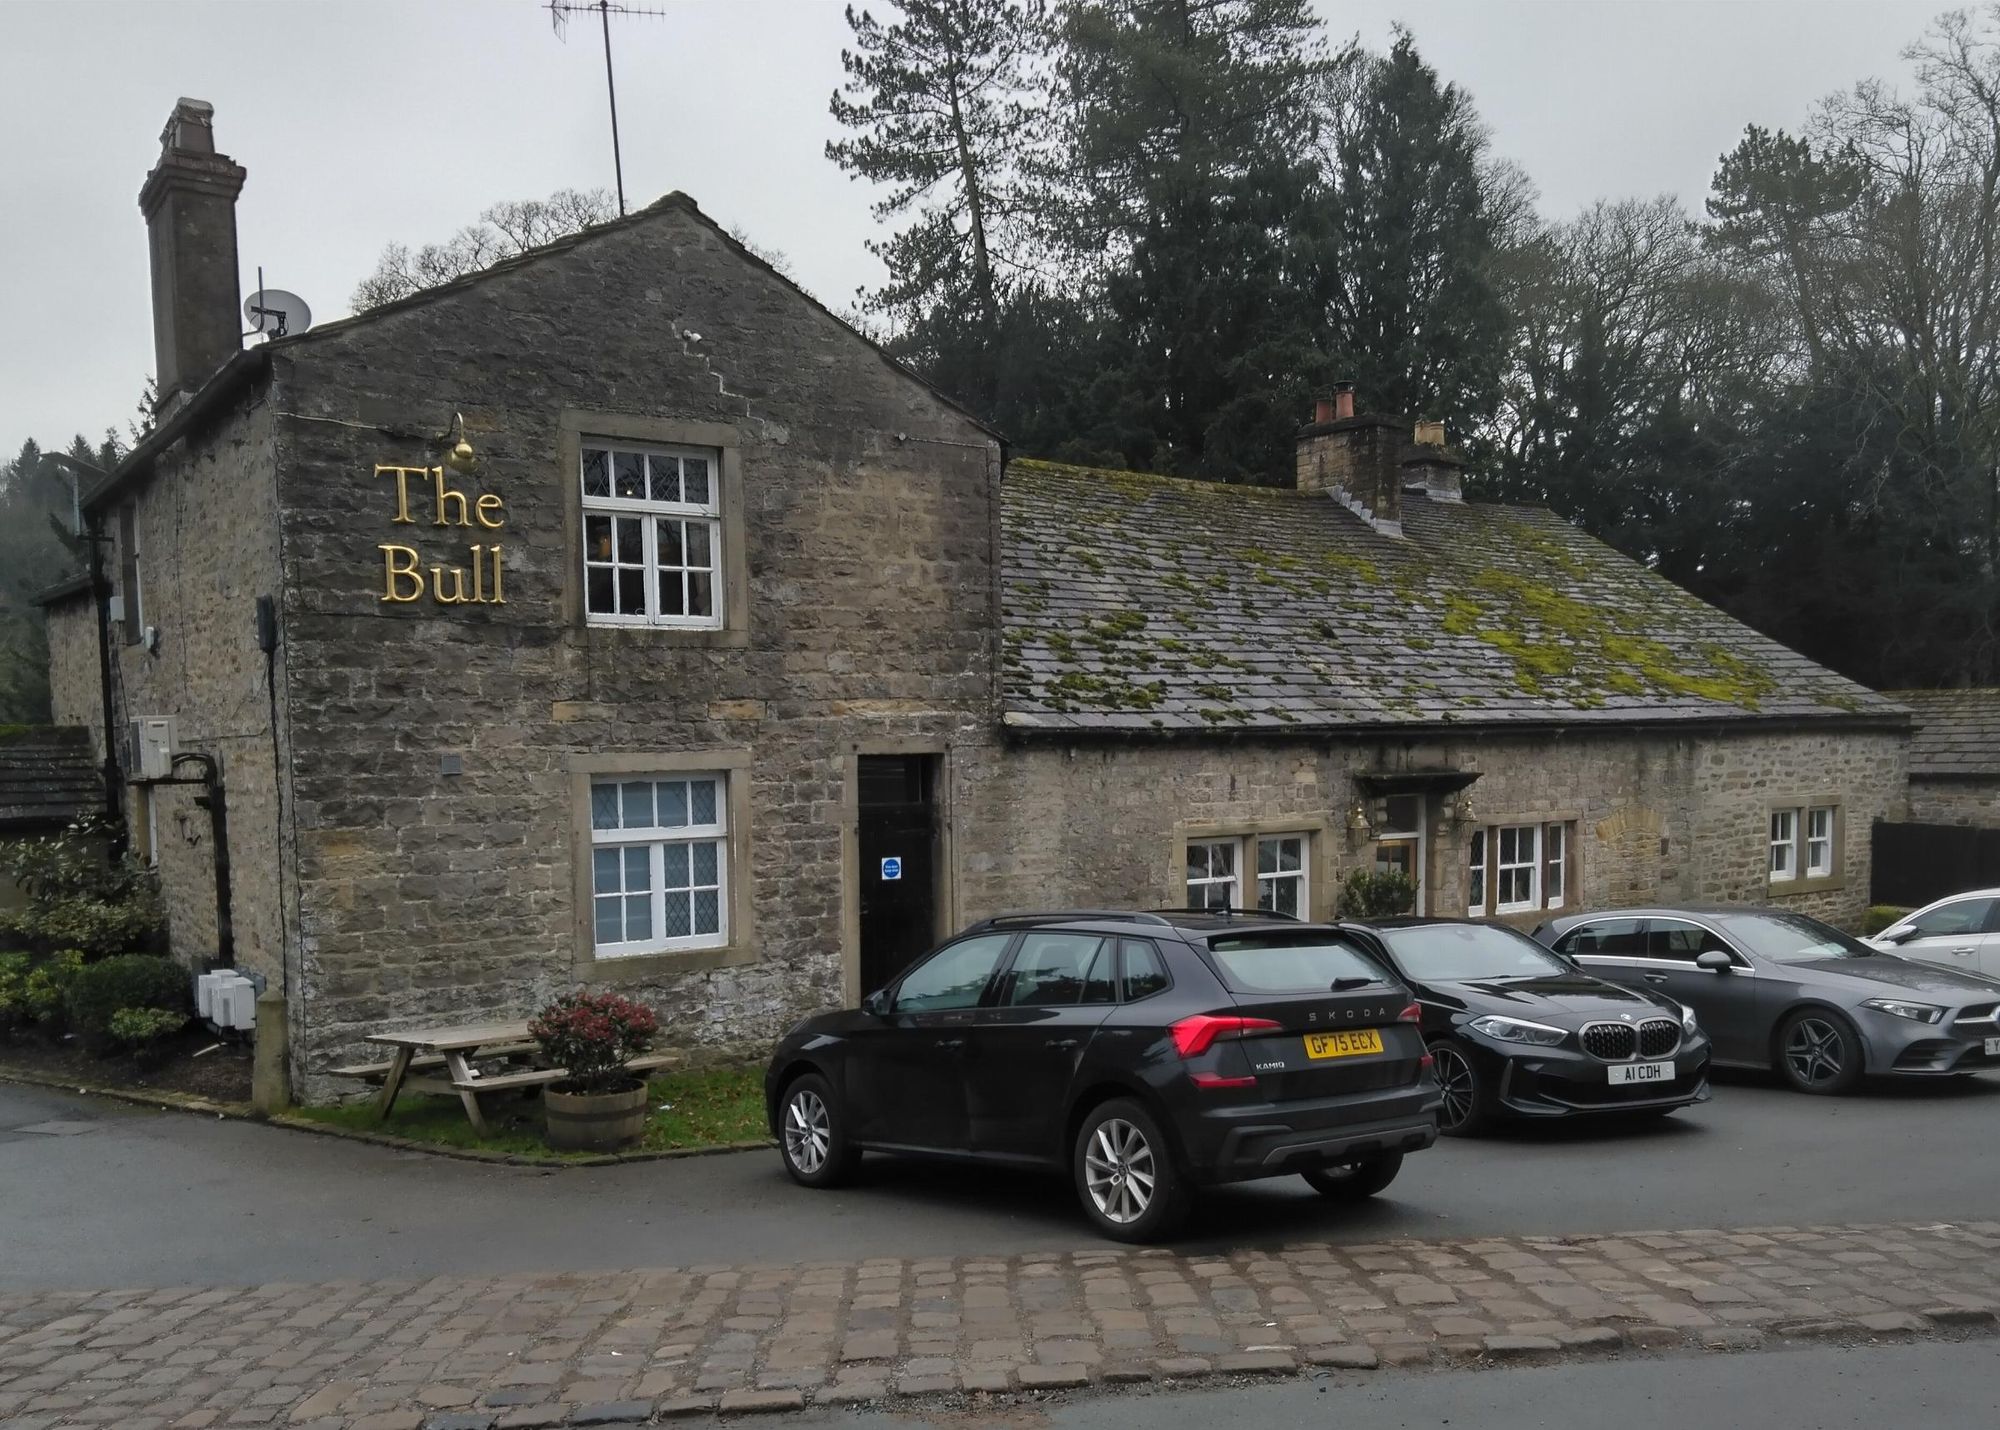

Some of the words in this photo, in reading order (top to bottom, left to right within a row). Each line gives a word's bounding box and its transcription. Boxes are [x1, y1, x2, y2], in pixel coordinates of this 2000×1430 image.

[374, 463, 505, 528] The
[378, 544, 507, 604] Bull
[1311, 1033, 1349, 1054] GF75
[1350, 1031, 1378, 1051] ECX
[1255, 1061, 1285, 1071] KAMIQ
[1638, 1064, 1661, 1079] CDH
